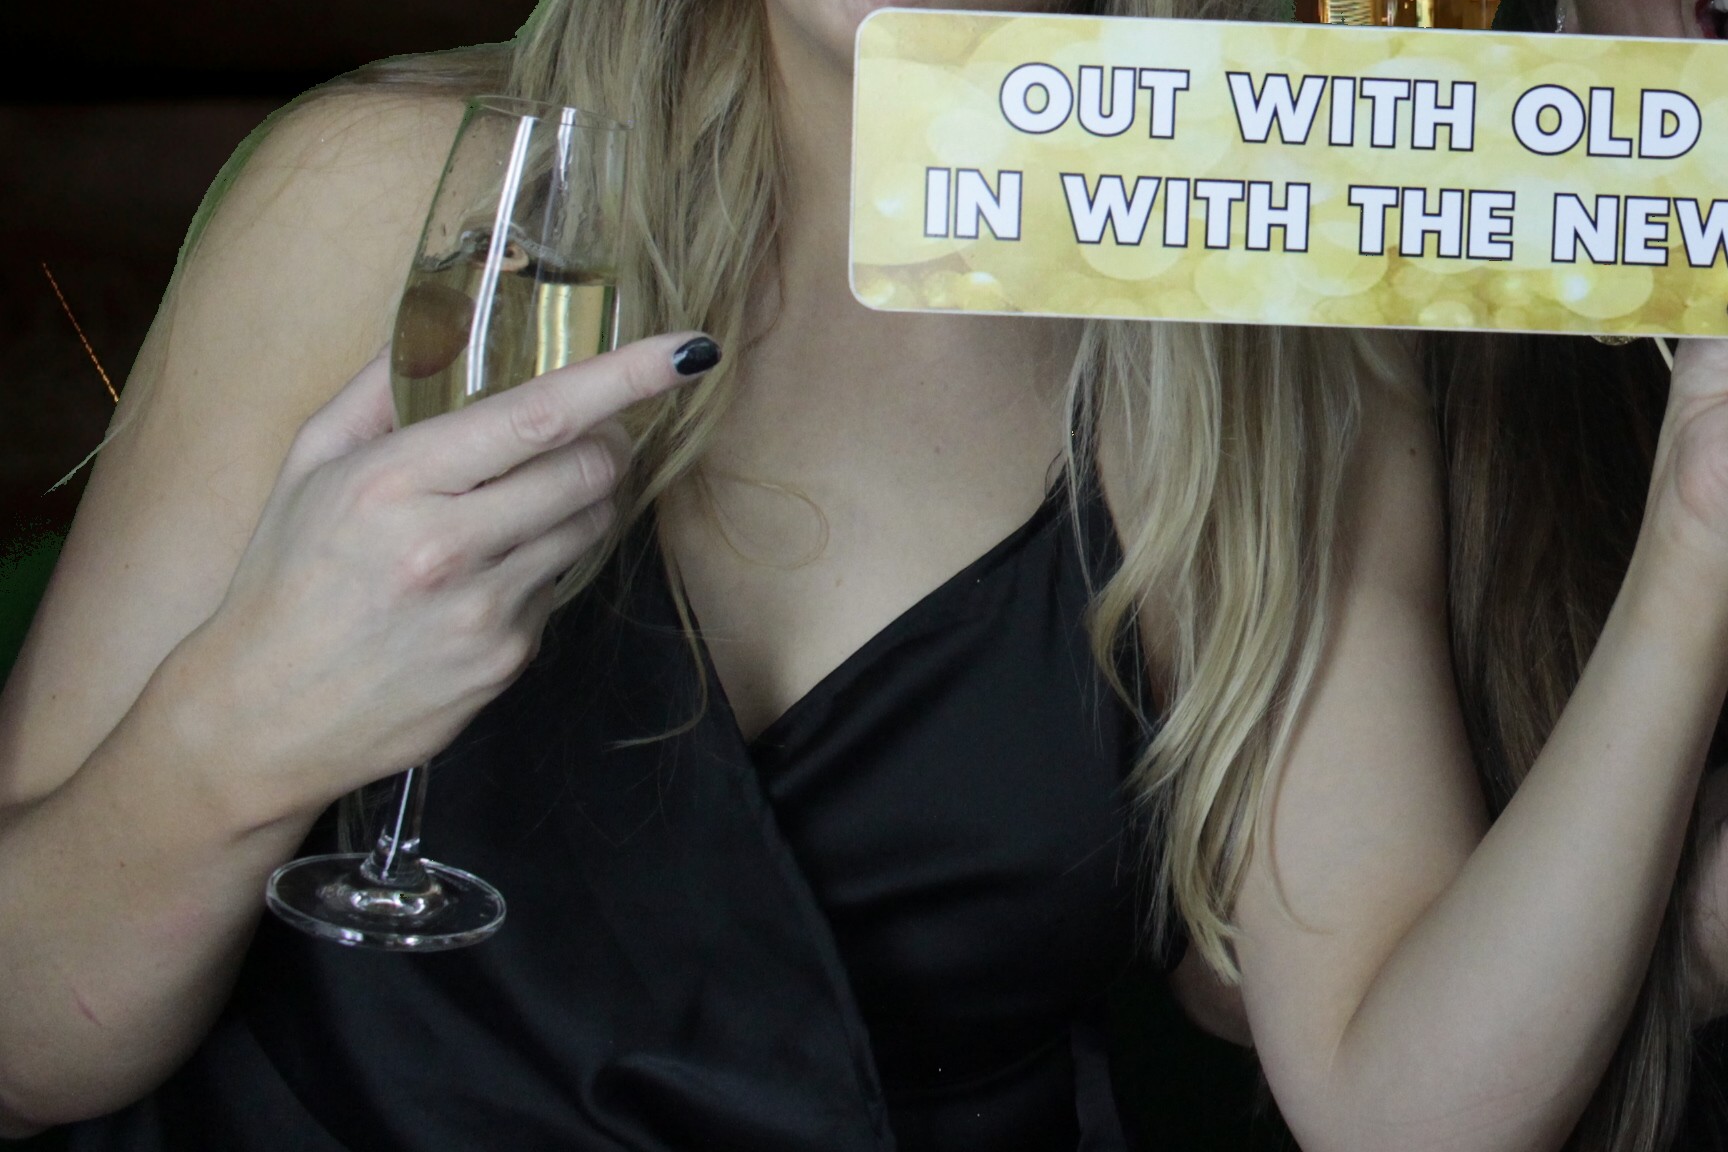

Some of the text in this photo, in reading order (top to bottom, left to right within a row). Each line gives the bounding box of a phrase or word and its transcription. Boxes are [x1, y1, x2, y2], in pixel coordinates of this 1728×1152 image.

[999, 62, 1702, 160] OUT WITH OLD
[924, 167, 1023, 241] IN
[1060, 172, 1310, 252] WITH
[1350, 185, 1515, 260] THE
